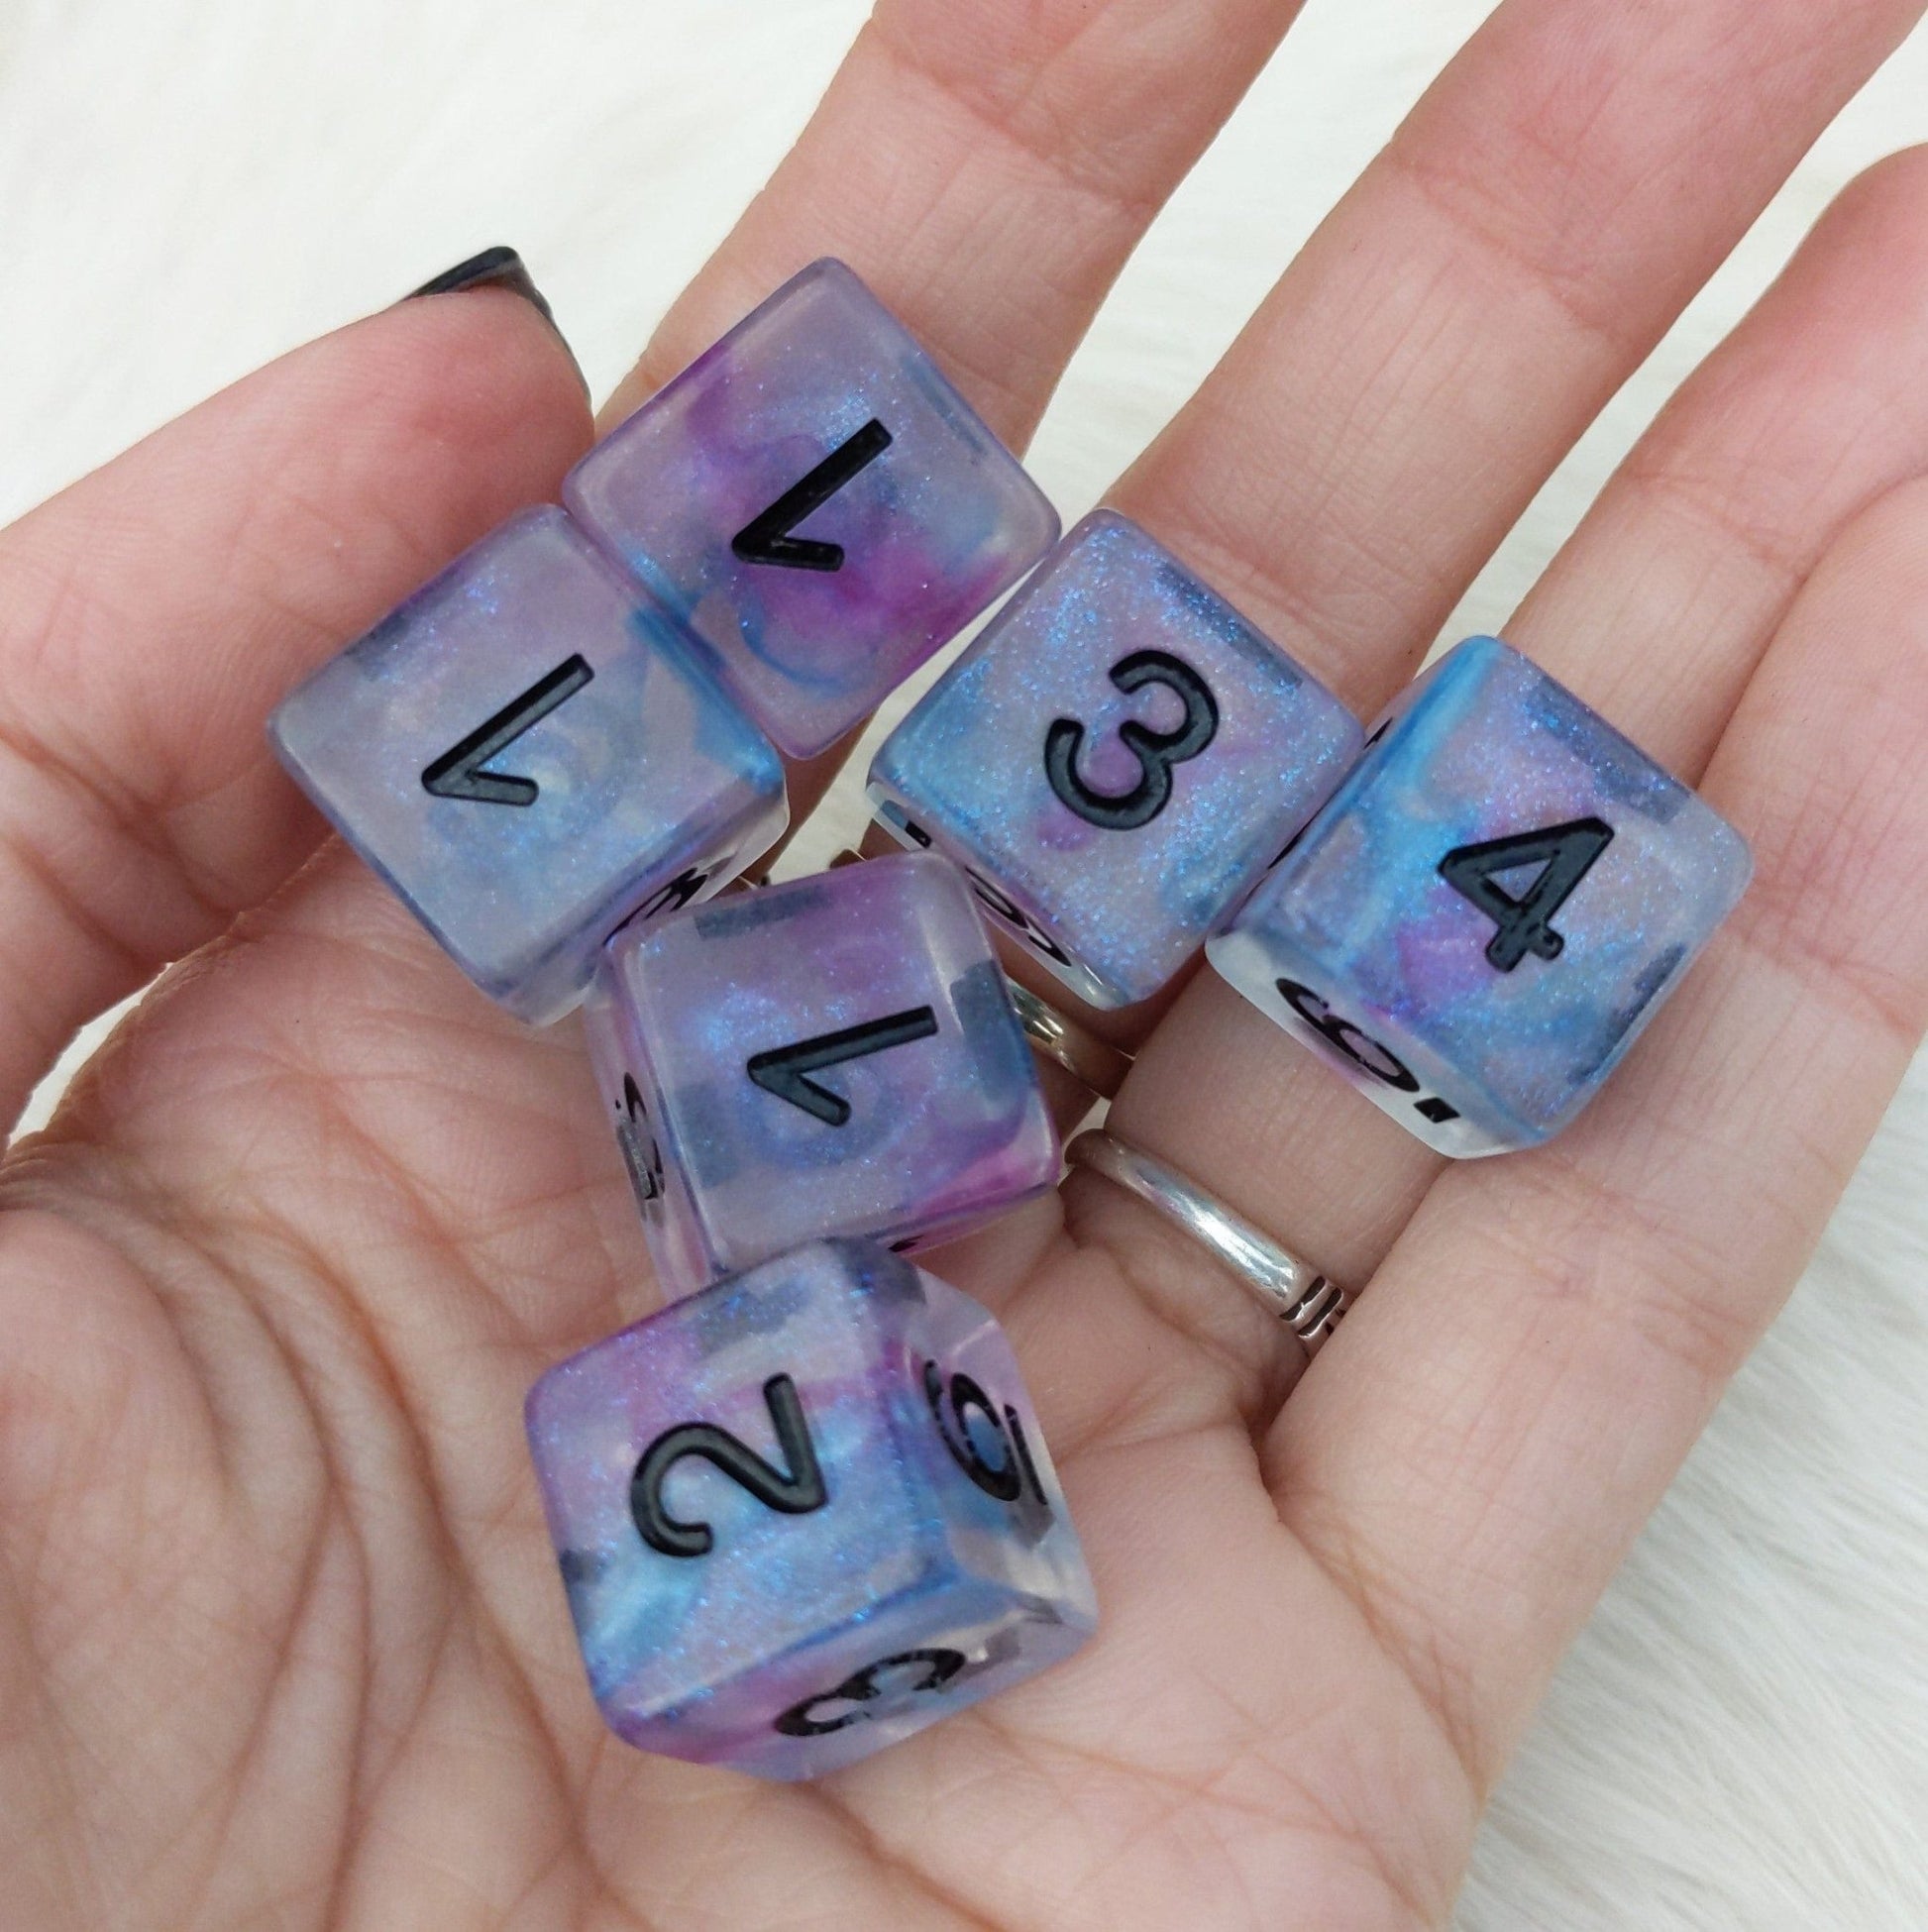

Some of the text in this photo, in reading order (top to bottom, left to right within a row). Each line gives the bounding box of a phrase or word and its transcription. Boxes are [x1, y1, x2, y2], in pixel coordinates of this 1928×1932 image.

[731, 417, 893, 573] 1
[421, 653, 594, 807] 1
[1044, 649, 1220, 830] 3
[1438, 816, 1615, 973] 4
[746, 1004, 939, 1127] 1
[629, 1371, 830, 1558] 2
[772, 1647, 967, 1737] 3
